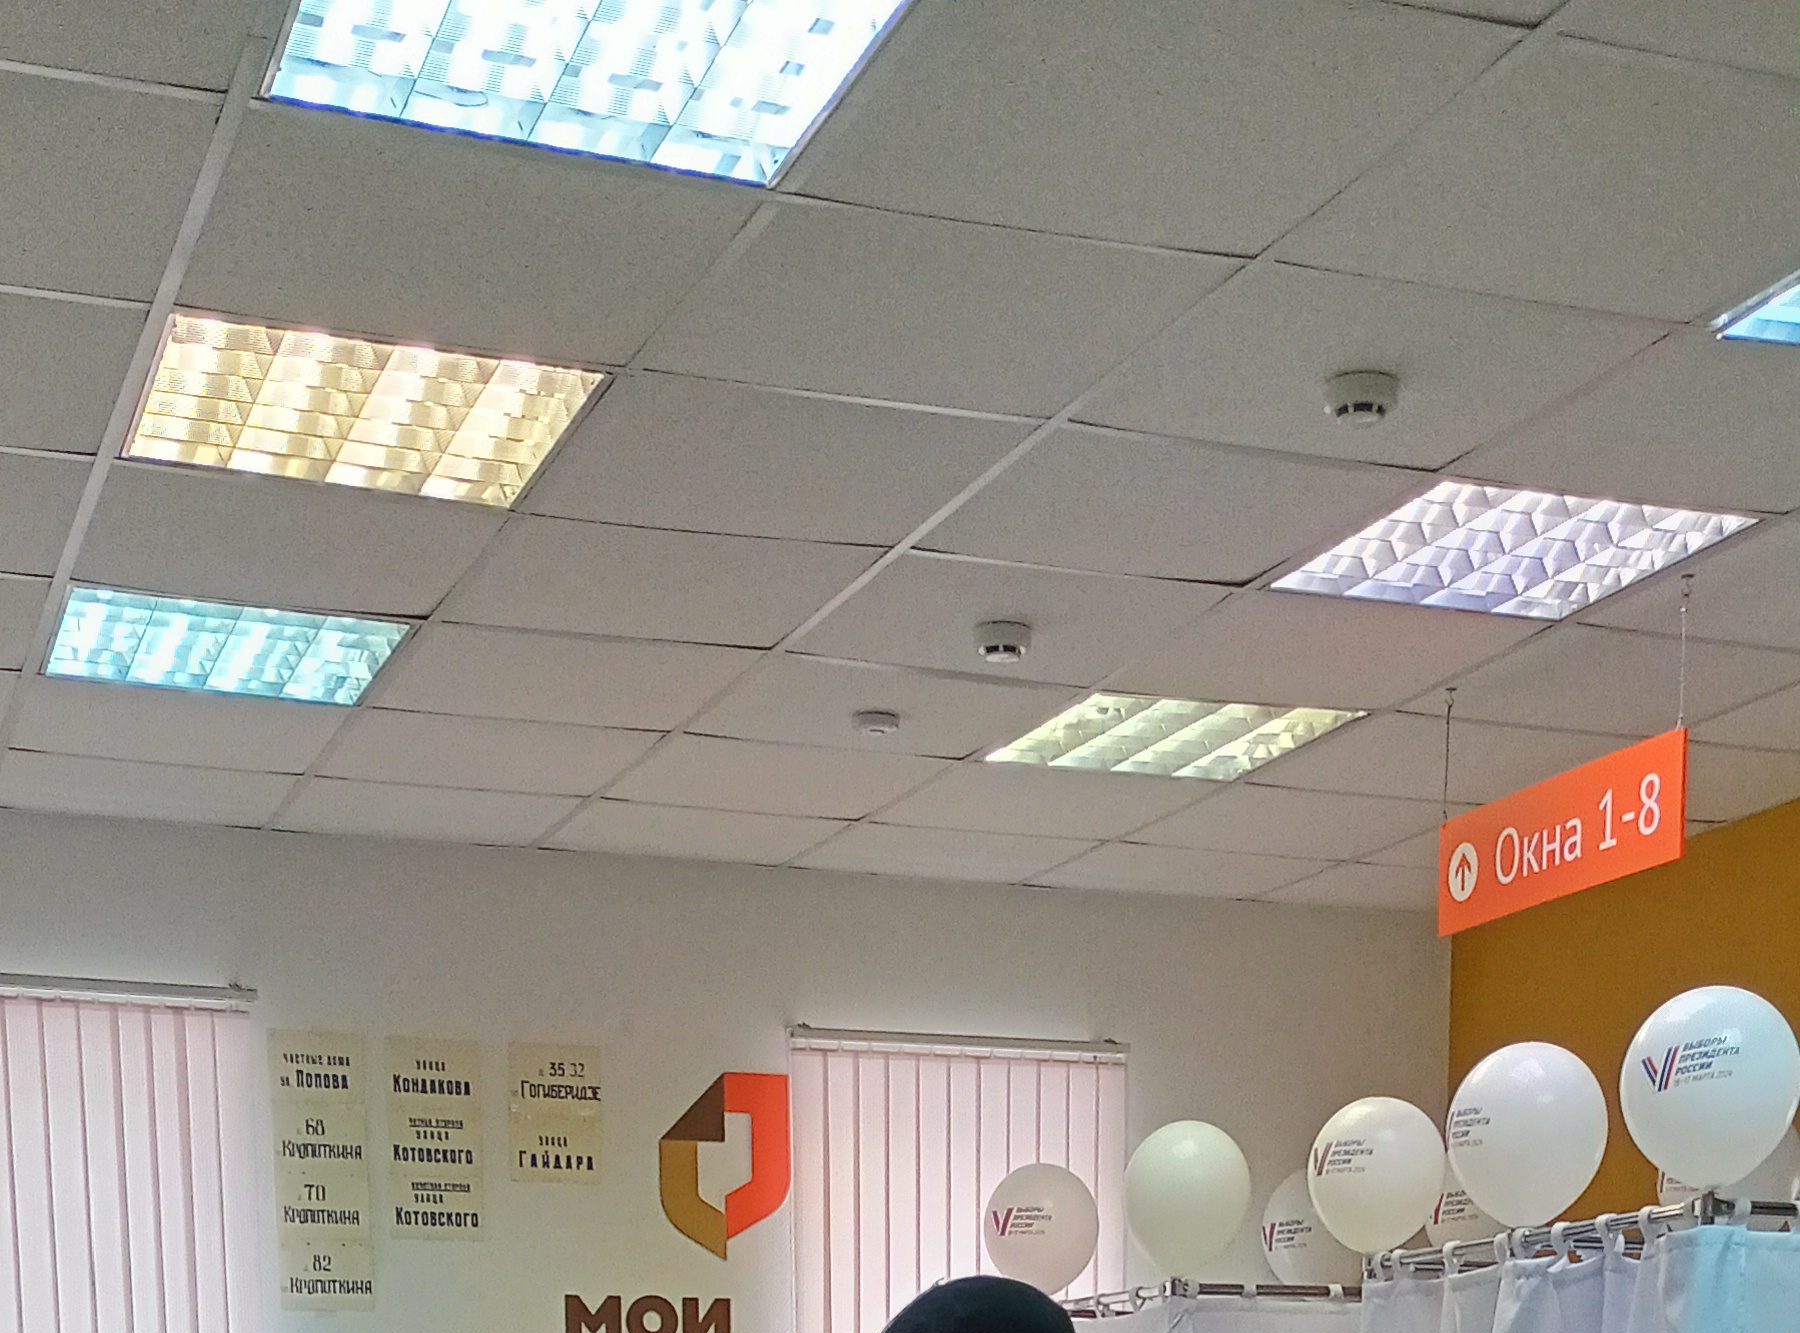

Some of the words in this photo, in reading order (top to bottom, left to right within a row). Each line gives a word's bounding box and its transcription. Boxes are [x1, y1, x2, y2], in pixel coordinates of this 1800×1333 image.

[1495, 817, 1582, 885] Окна
[1598, 772, 1661, 851] 1-8
[1682, 1035, 1727, 1052] ВЫБОРЫ
[1679, 1046, 1740, 1063] ПРЕЗИДЕНТА
[548, 1062, 566, 1077] 35
[1675, 1061, 1713, 1076] РОССИИ
[296, 1069, 348, 1090] ПОПОВА
[393, 1073, 470, 1096] КОНДАКОВА
[305, 1118, 325, 1136] 68
[282, 1140, 362, 1160] КРОПОТКИНА
[393, 1144, 473, 1164] КОТОВСКОГО
[519, 1150, 594, 1170] ГАЙДАРА
[304, 1184, 326, 1201] 70
[284, 1205, 360, 1226] КРОПОТКИНА
[396, 1206, 478, 1227] КОТОВСКОГО
[313, 1254, 332, 1272] 82
[290, 1277, 373, 1295] КРОПОТКИНА
